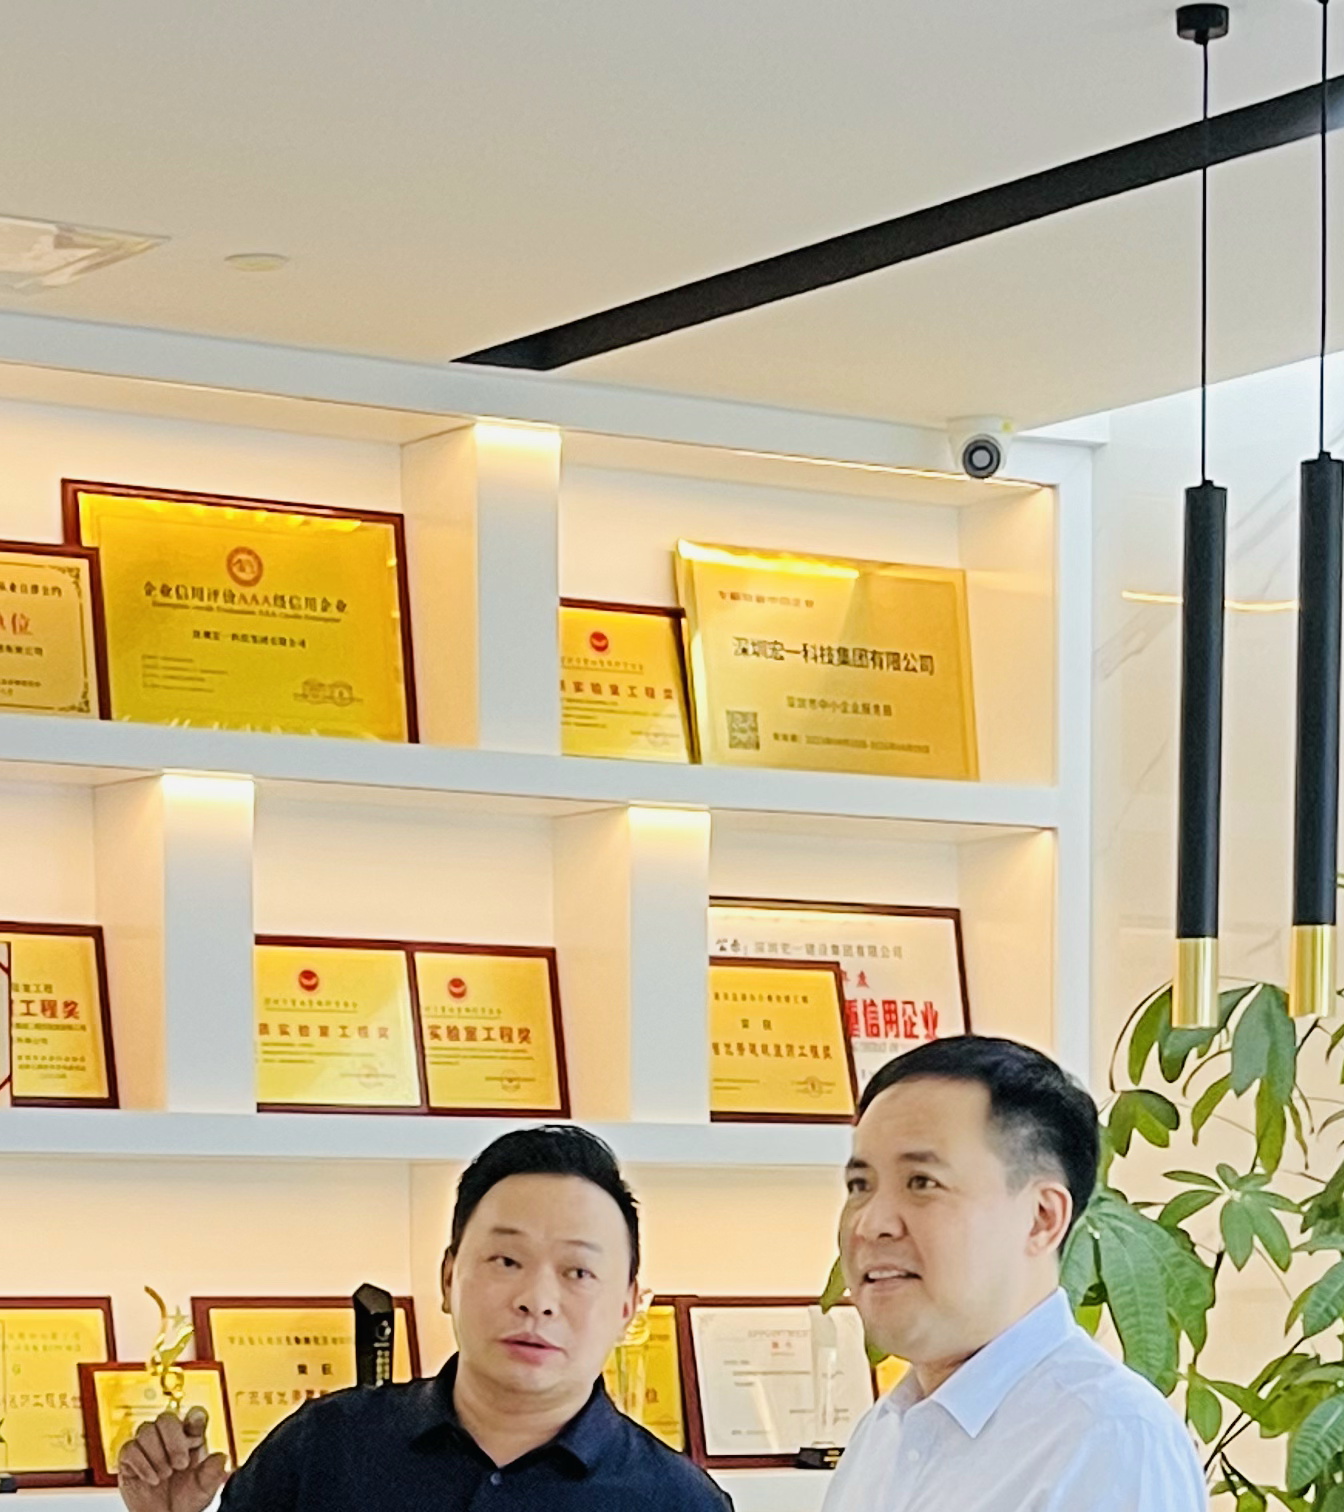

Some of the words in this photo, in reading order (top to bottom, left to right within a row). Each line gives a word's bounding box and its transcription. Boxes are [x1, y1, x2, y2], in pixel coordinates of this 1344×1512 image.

[732, 636, 936, 677] 深圳宏一科技集团有限公司
